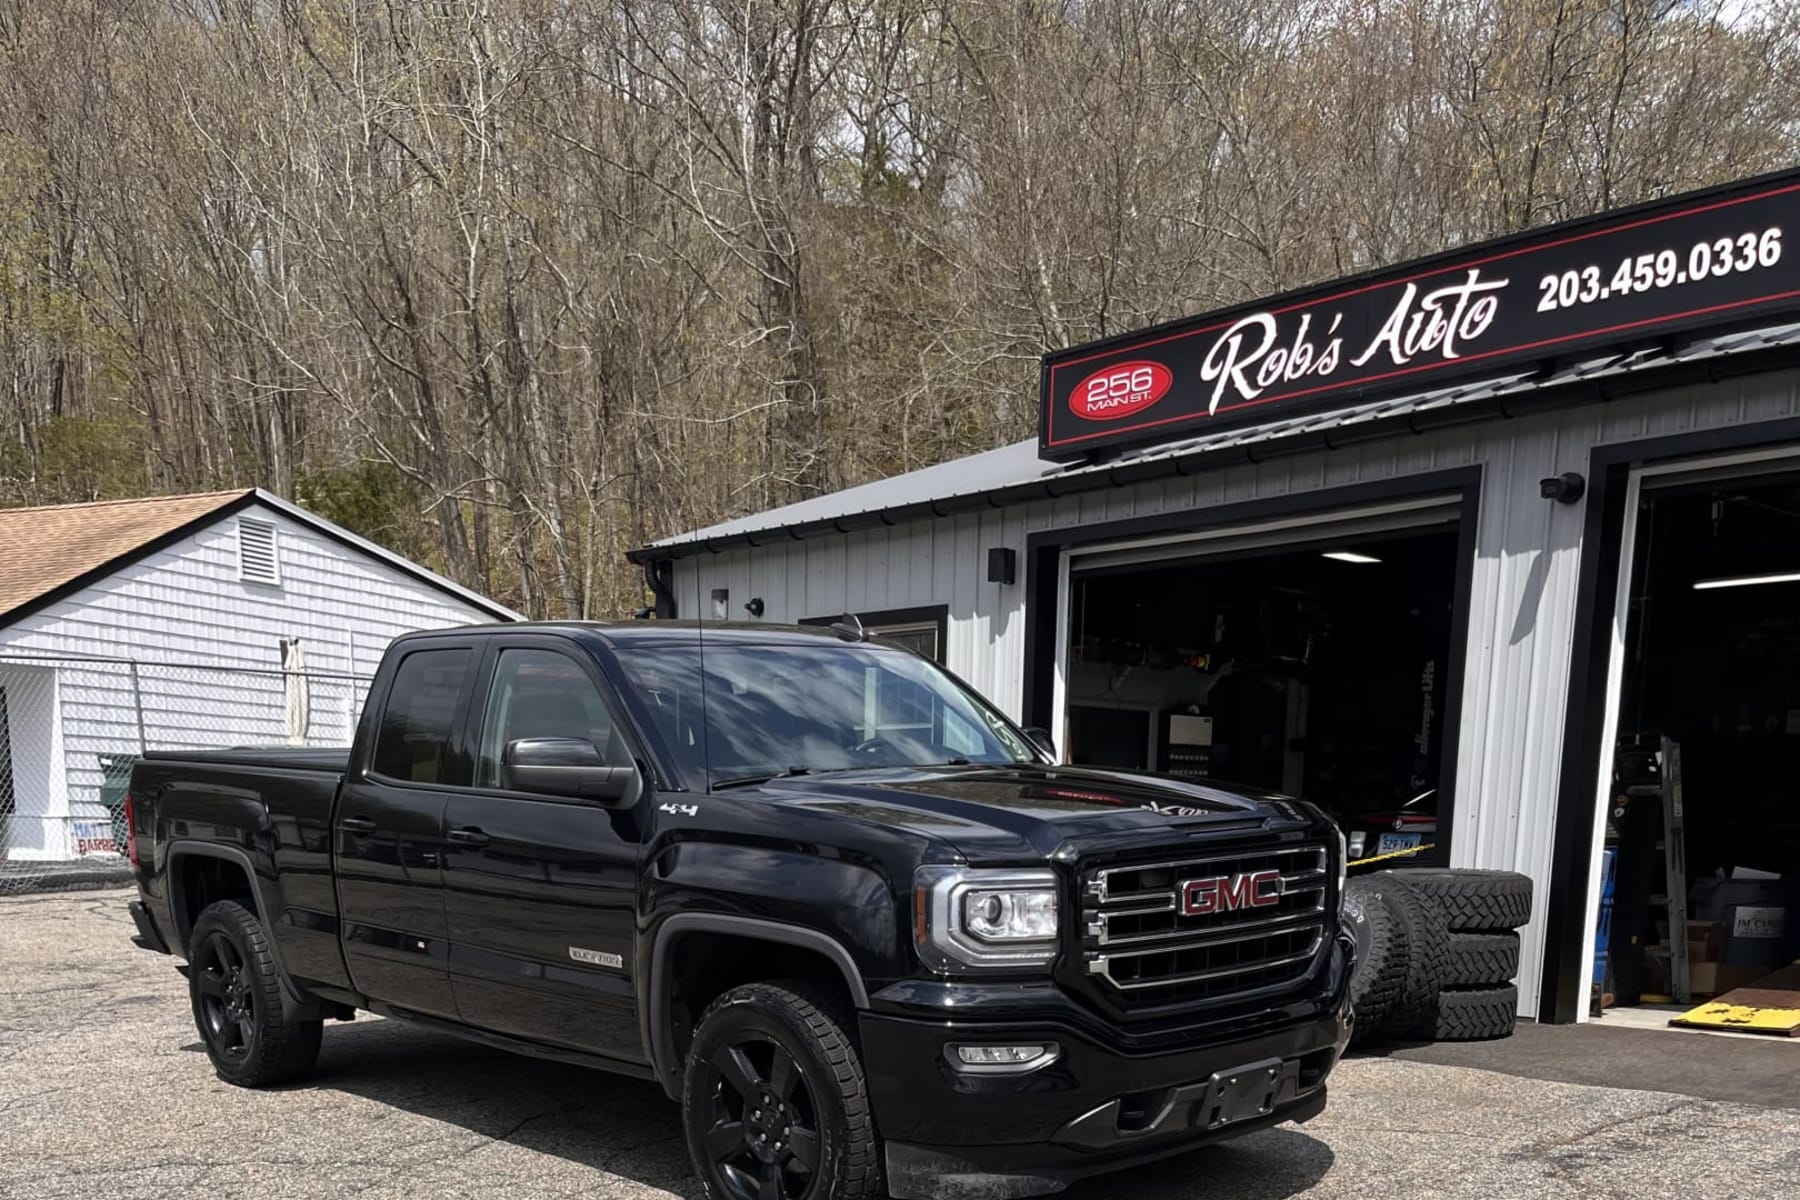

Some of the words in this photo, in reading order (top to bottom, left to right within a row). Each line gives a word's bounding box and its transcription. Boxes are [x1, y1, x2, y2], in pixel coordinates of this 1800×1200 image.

[1537, 226, 1782, 313] 203.459.0336
[1200, 311, 1341, 416] Rob's
[1350, 269, 1509, 365] Auto
[1087, 367, 1152, 402] 256
[1087, 396, 1128, 412] MAIN
[1180, 868, 1281, 917] GMC
